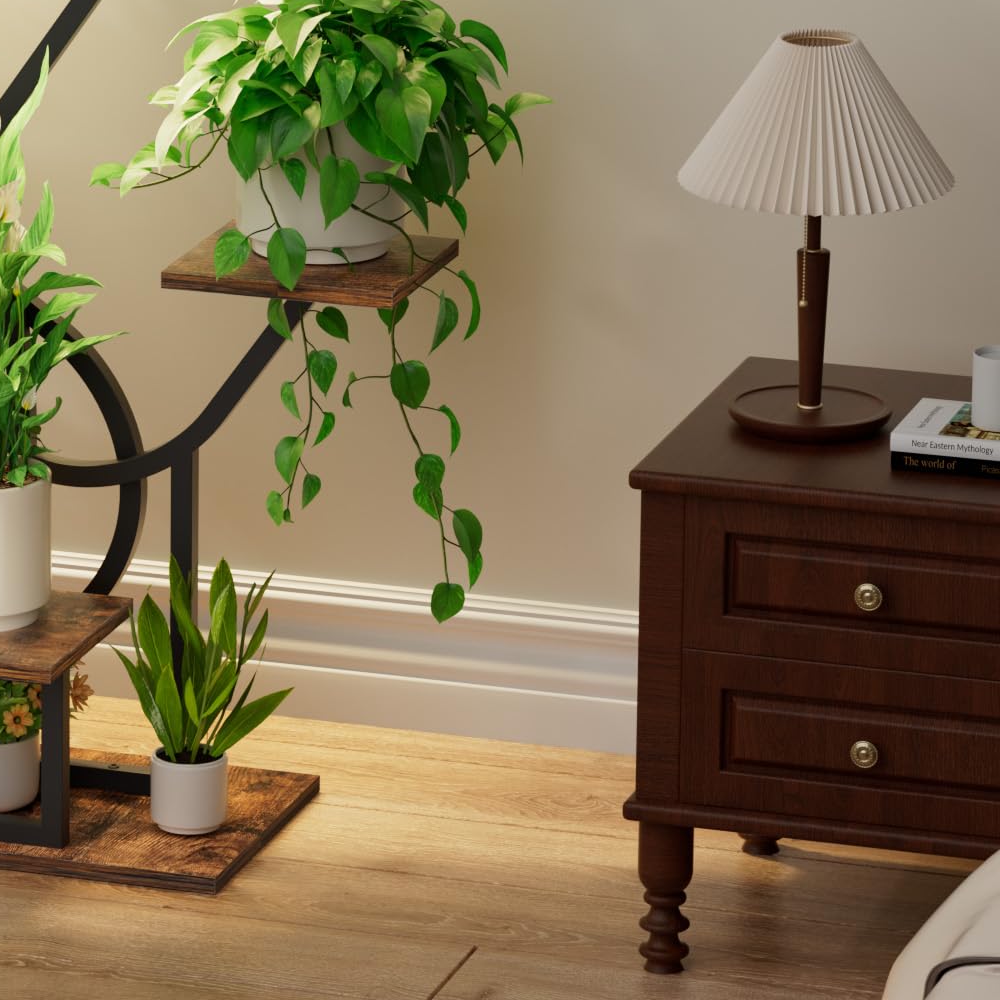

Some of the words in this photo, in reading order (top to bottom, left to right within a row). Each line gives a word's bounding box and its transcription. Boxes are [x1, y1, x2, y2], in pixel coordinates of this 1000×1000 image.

[911, 440, 928, 448] Near
[929, 441, 955, 450] Eastern
[956, 444, 994, 455] Mythology
[903, 456, 919, 466] The
[921, 458, 945, 469] world
[946, 460, 956, 470] of
